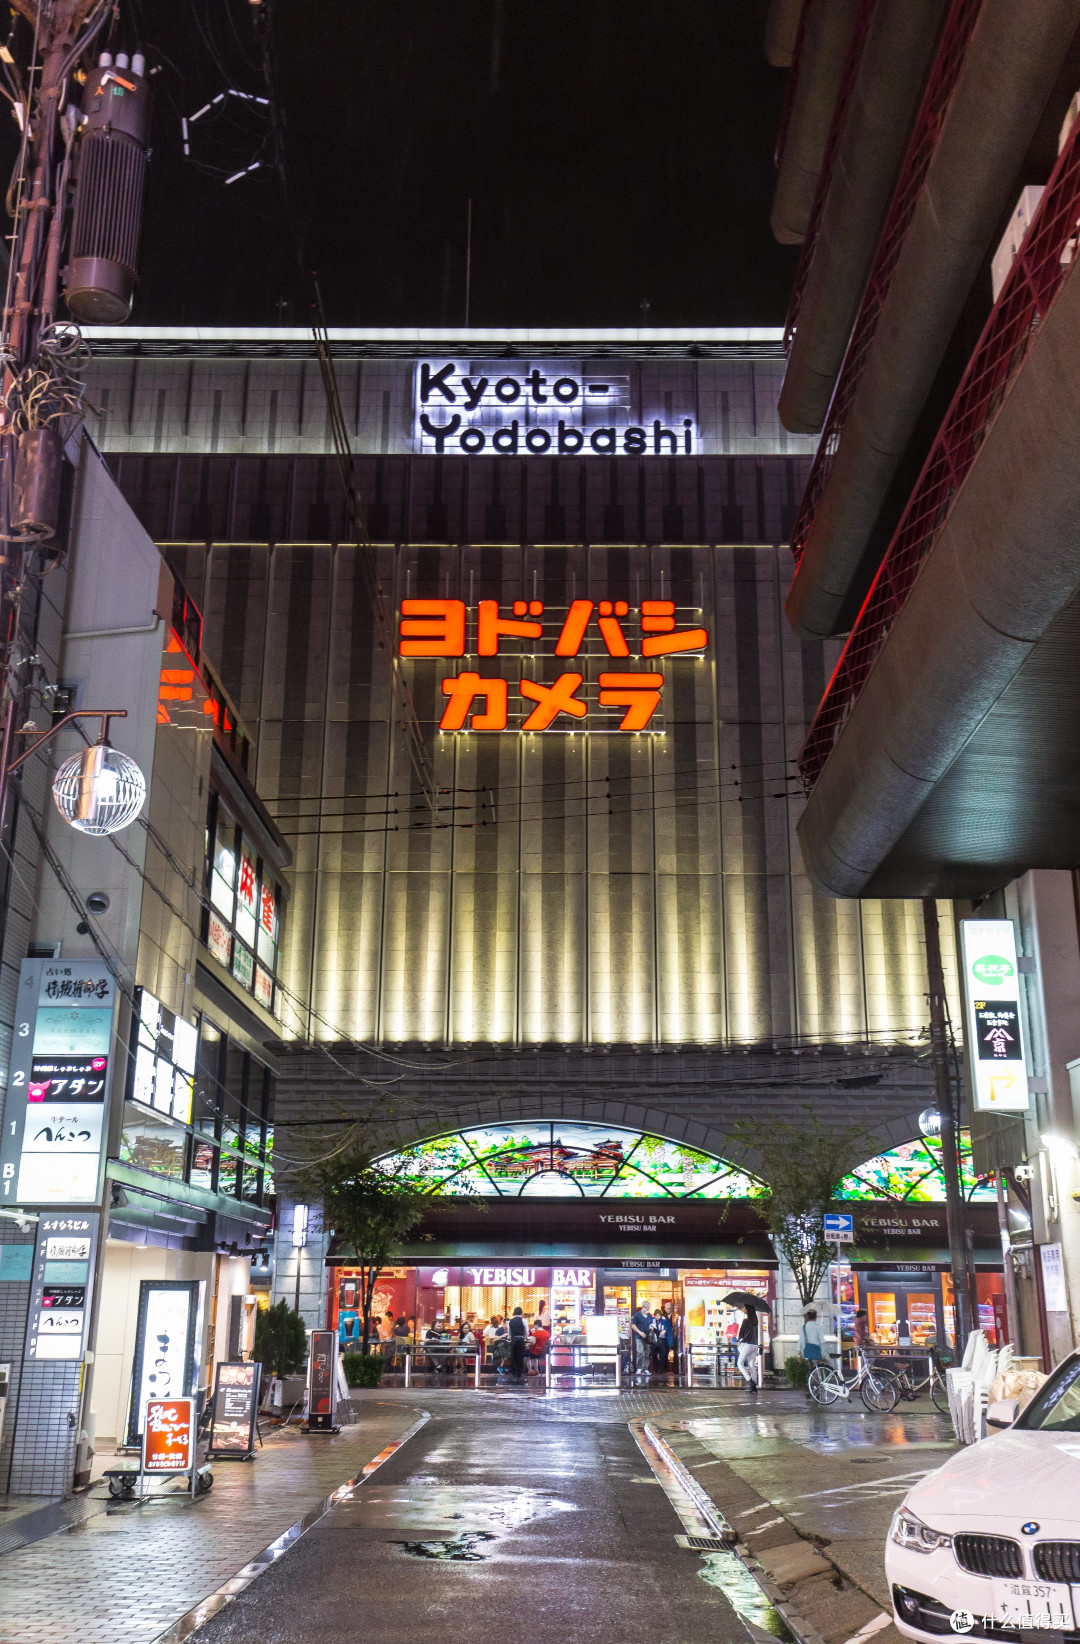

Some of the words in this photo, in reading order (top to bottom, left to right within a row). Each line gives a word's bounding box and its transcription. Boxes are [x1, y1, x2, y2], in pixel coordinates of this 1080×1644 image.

[420, 363, 609, 411] Kyoto-
[420, 413, 692, 454] Yodobashi
[399, 599, 708, 657] ヨドバシ
[439, 672, 664, 731] カメラ
[46, 967, 72, 976] 占い処
[24, 975, 34, 988] 4
[974, 1001, 986, 1010] 2F
[18, 1023, 30, 1036] 3
[12, 1071, 25, 1086] 2
[51, 1078, 104, 1095] アダン
[10, 1121, 17, 1135] 1
[33, 1127, 92, 1142] へんこつ
[599, 1215, 645, 1223] YEBISU
[649, 1215, 676, 1223] BAR
[861, 1218, 908, 1227] YEBISU
[912, 1219, 940, 1227] BAR
[470, 1268, 535, 1285] YEBISU
[553, 1269, 590, 1286] BAR
[54, 1295, 84, 1305] アダン
[1010, 1583, 1031, 1596] 滋賀
[1033, 1585, 1051, 1598] 357
